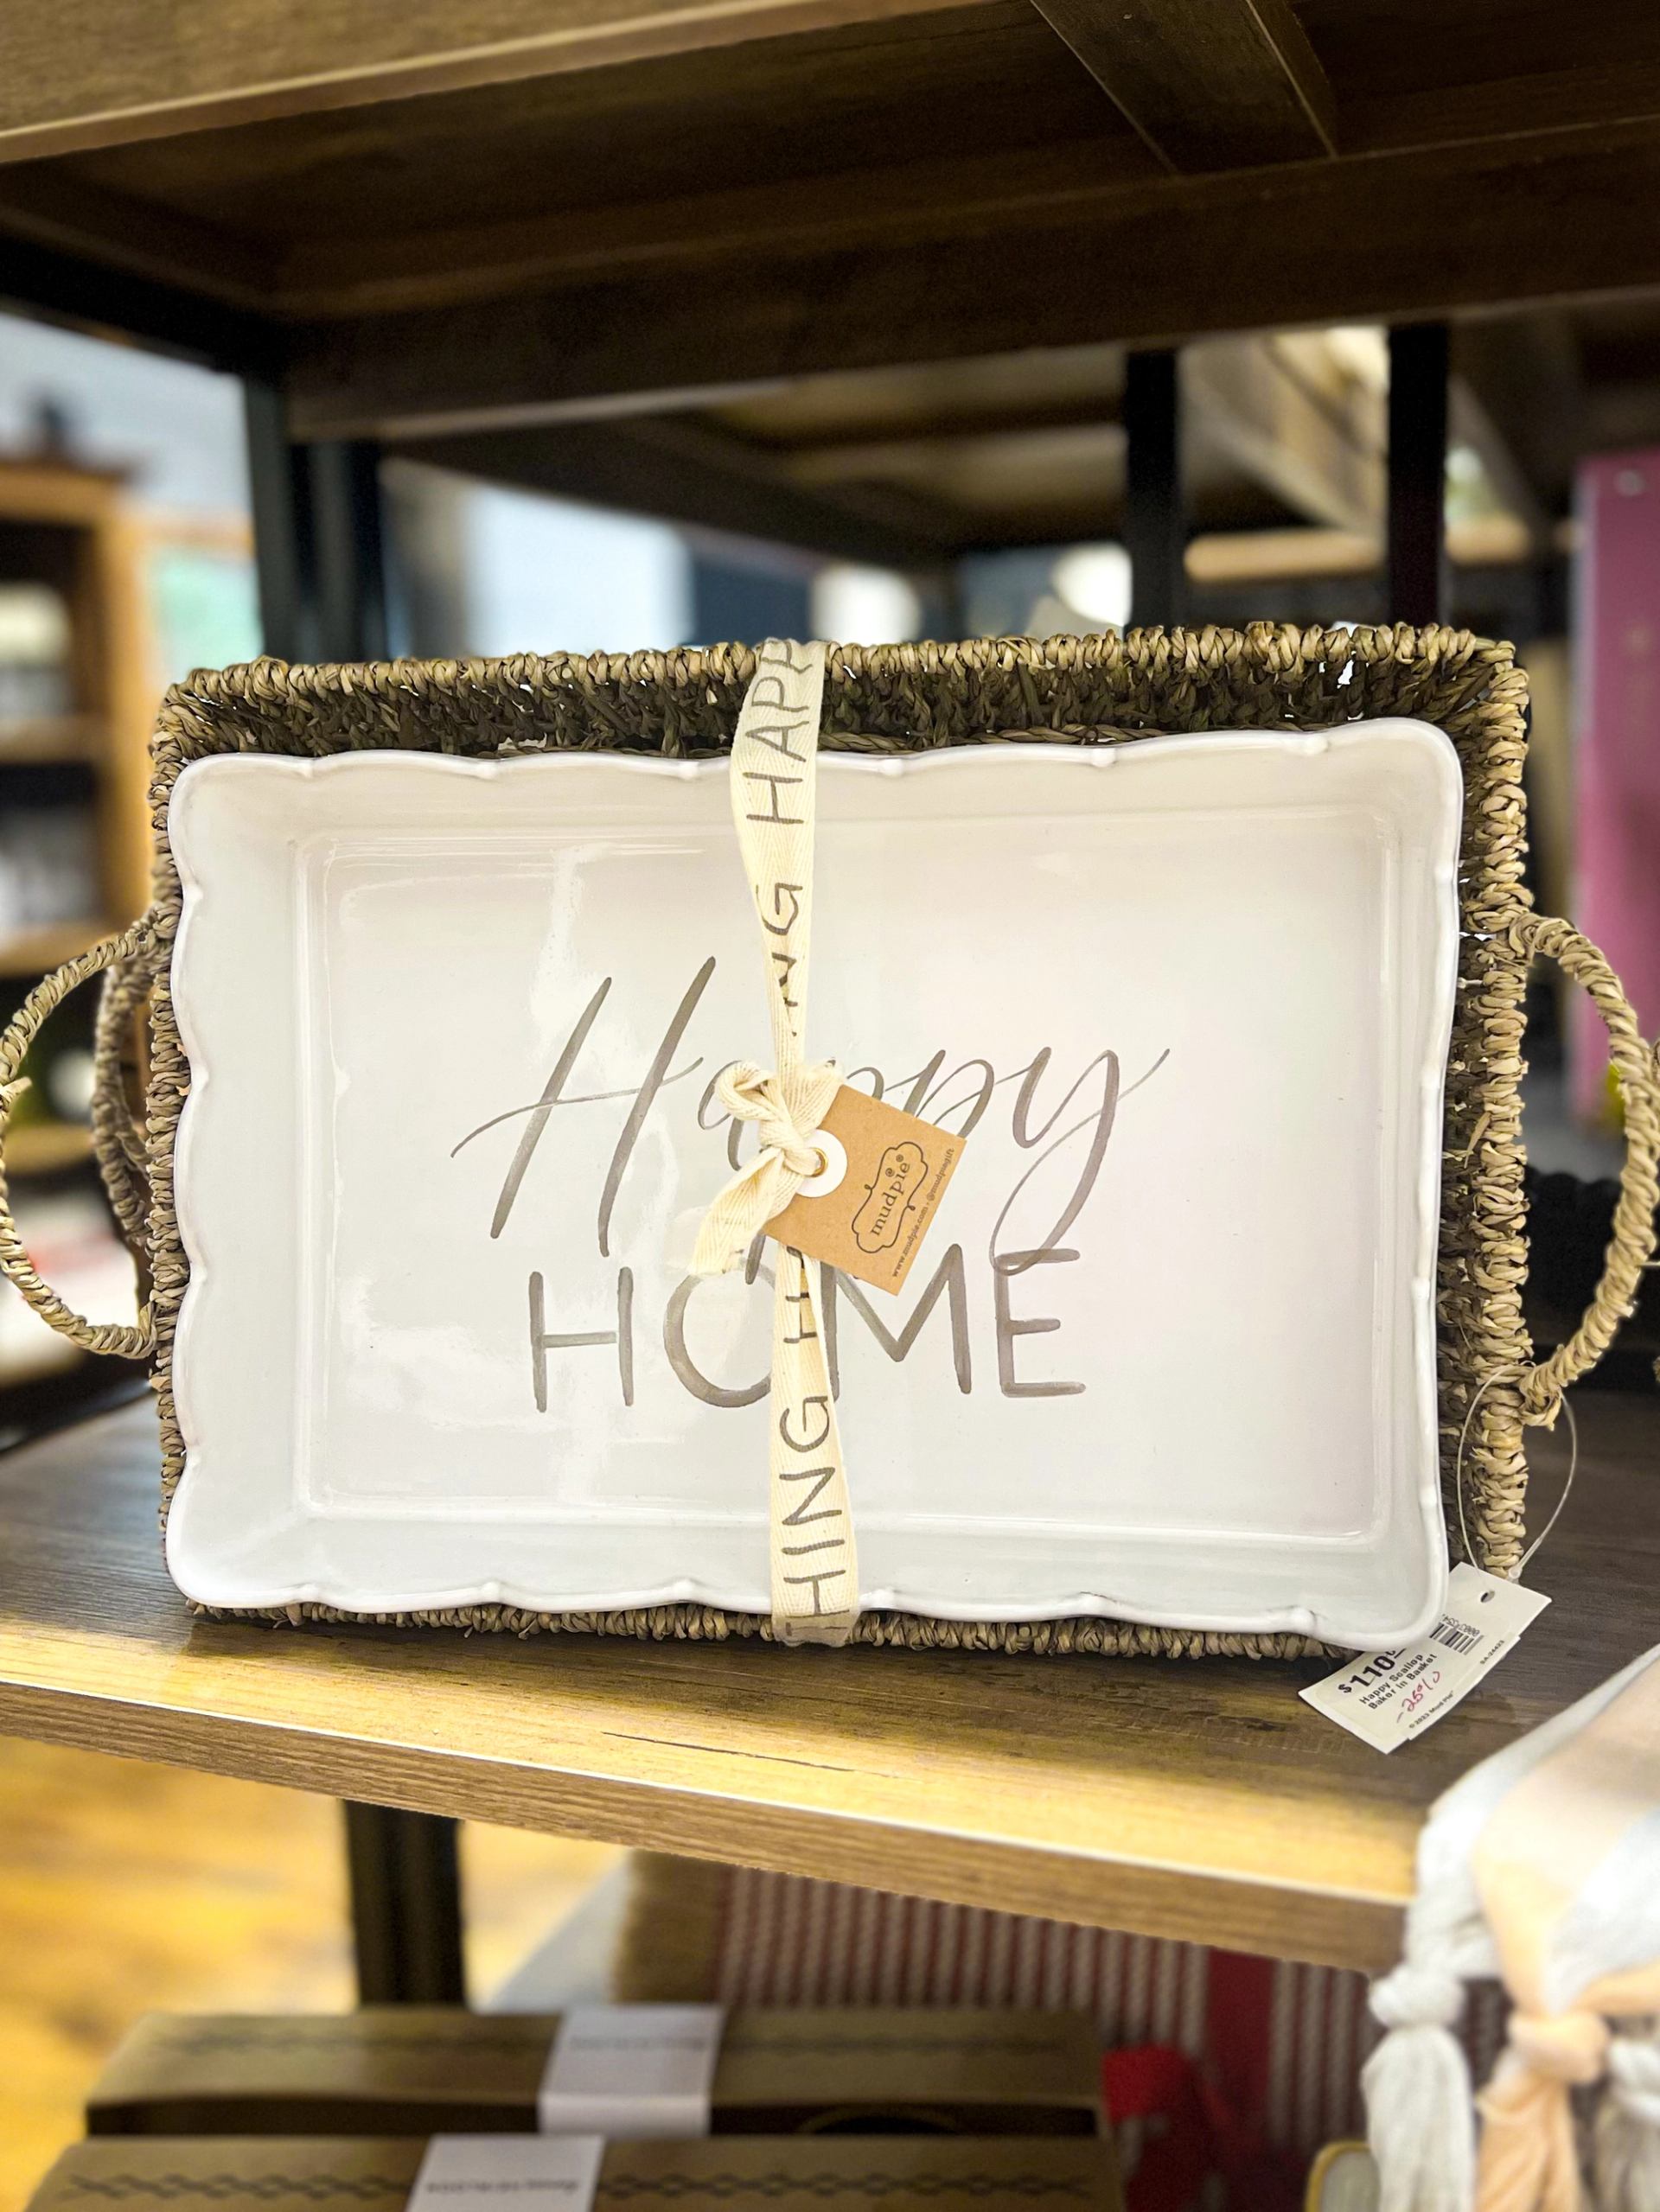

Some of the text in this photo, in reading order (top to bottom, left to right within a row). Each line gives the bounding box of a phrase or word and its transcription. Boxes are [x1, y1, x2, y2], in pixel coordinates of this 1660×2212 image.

[871, 1154, 910, 1236] mudpie
[892, 1206, 929, 1278] www.mudpie.com
[528, 1243, 1088, 1413] HOME
[1358, 1654, 1424, 1705] Happy Scallop
[1368, 1689, 1397, 1710] Baker
[1406, 1654, 1438, 1680] Basket
